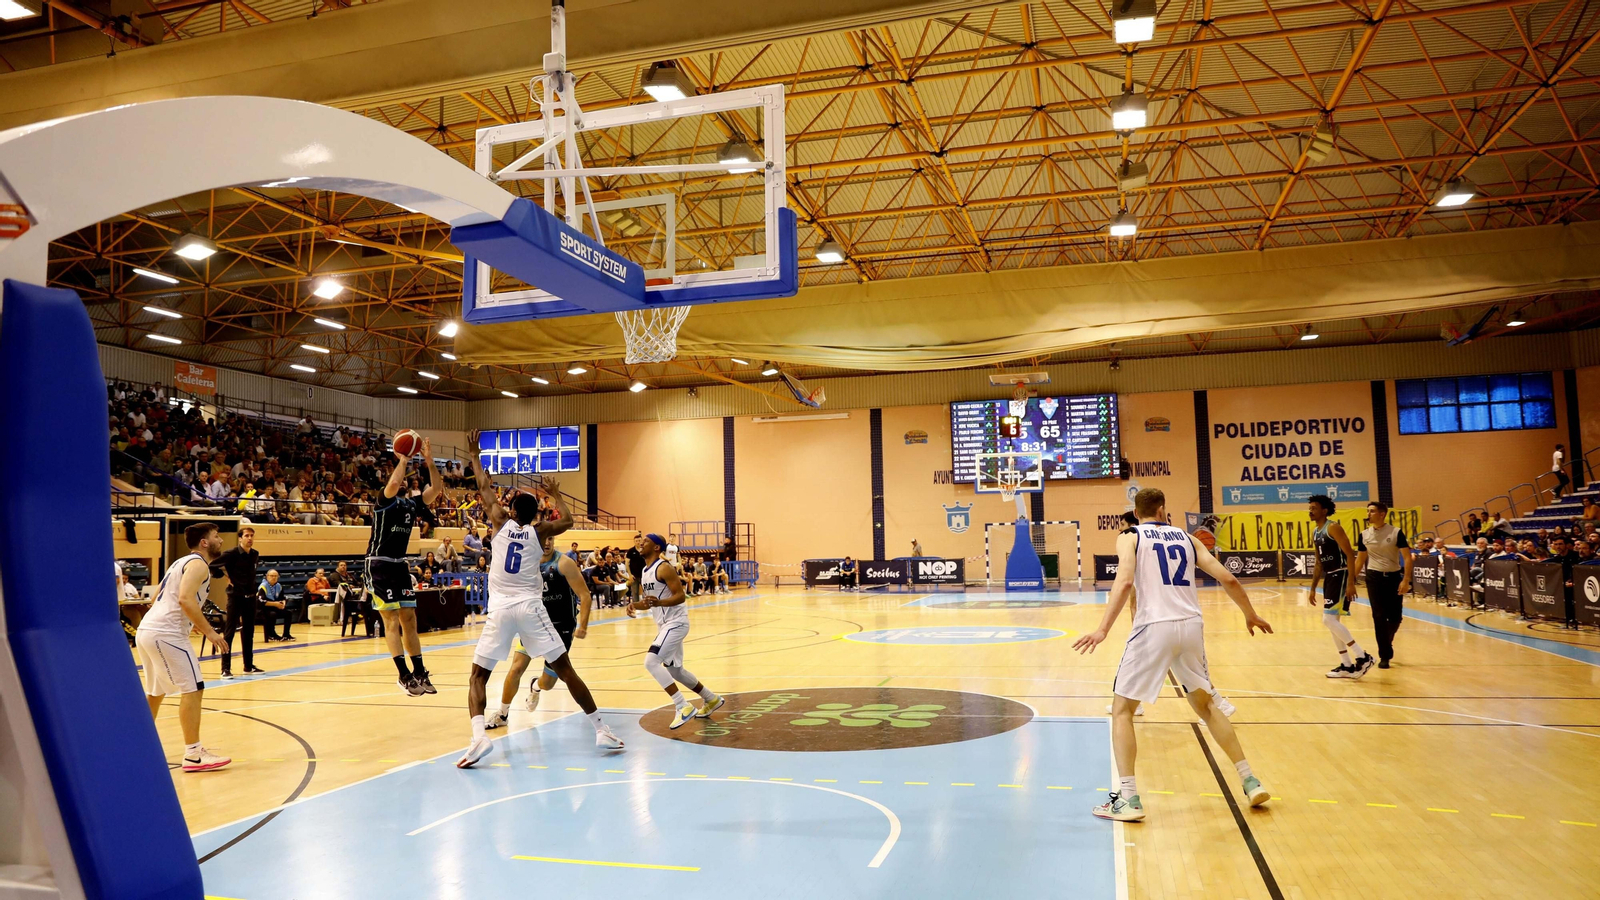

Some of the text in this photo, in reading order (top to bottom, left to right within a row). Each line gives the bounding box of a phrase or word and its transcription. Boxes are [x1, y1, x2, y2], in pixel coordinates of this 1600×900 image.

[560, 231, 627, 279] SPORT SYSTEM
[189, 365, 204, 376] Bar
[177, 373, 215, 388] Cafeteria
[1040, 426, 1060, 438] 65
[1214, 417, 1365, 438] POLIDEPORTIVO
[1021, 441, 1047, 452] 8:31
[1241, 440, 1344, 460] CIUDAD DE
[1135, 461, 1171, 477] MUNICIPAL
[1240, 462, 1346, 482] ALGECIRAS
[933, 470, 953, 484] AYUNT
[405, 513, 411, 524] 2
[507, 529, 529, 540] TAIWO
[1255, 514, 1314, 551] FORTAL
[504, 541, 524, 574] 6
[1153, 543, 1190, 587] 12
[866, 567, 900, 579] Socibus
[918, 561, 957, 576] NOP
[386, 589, 393, 599] 2
